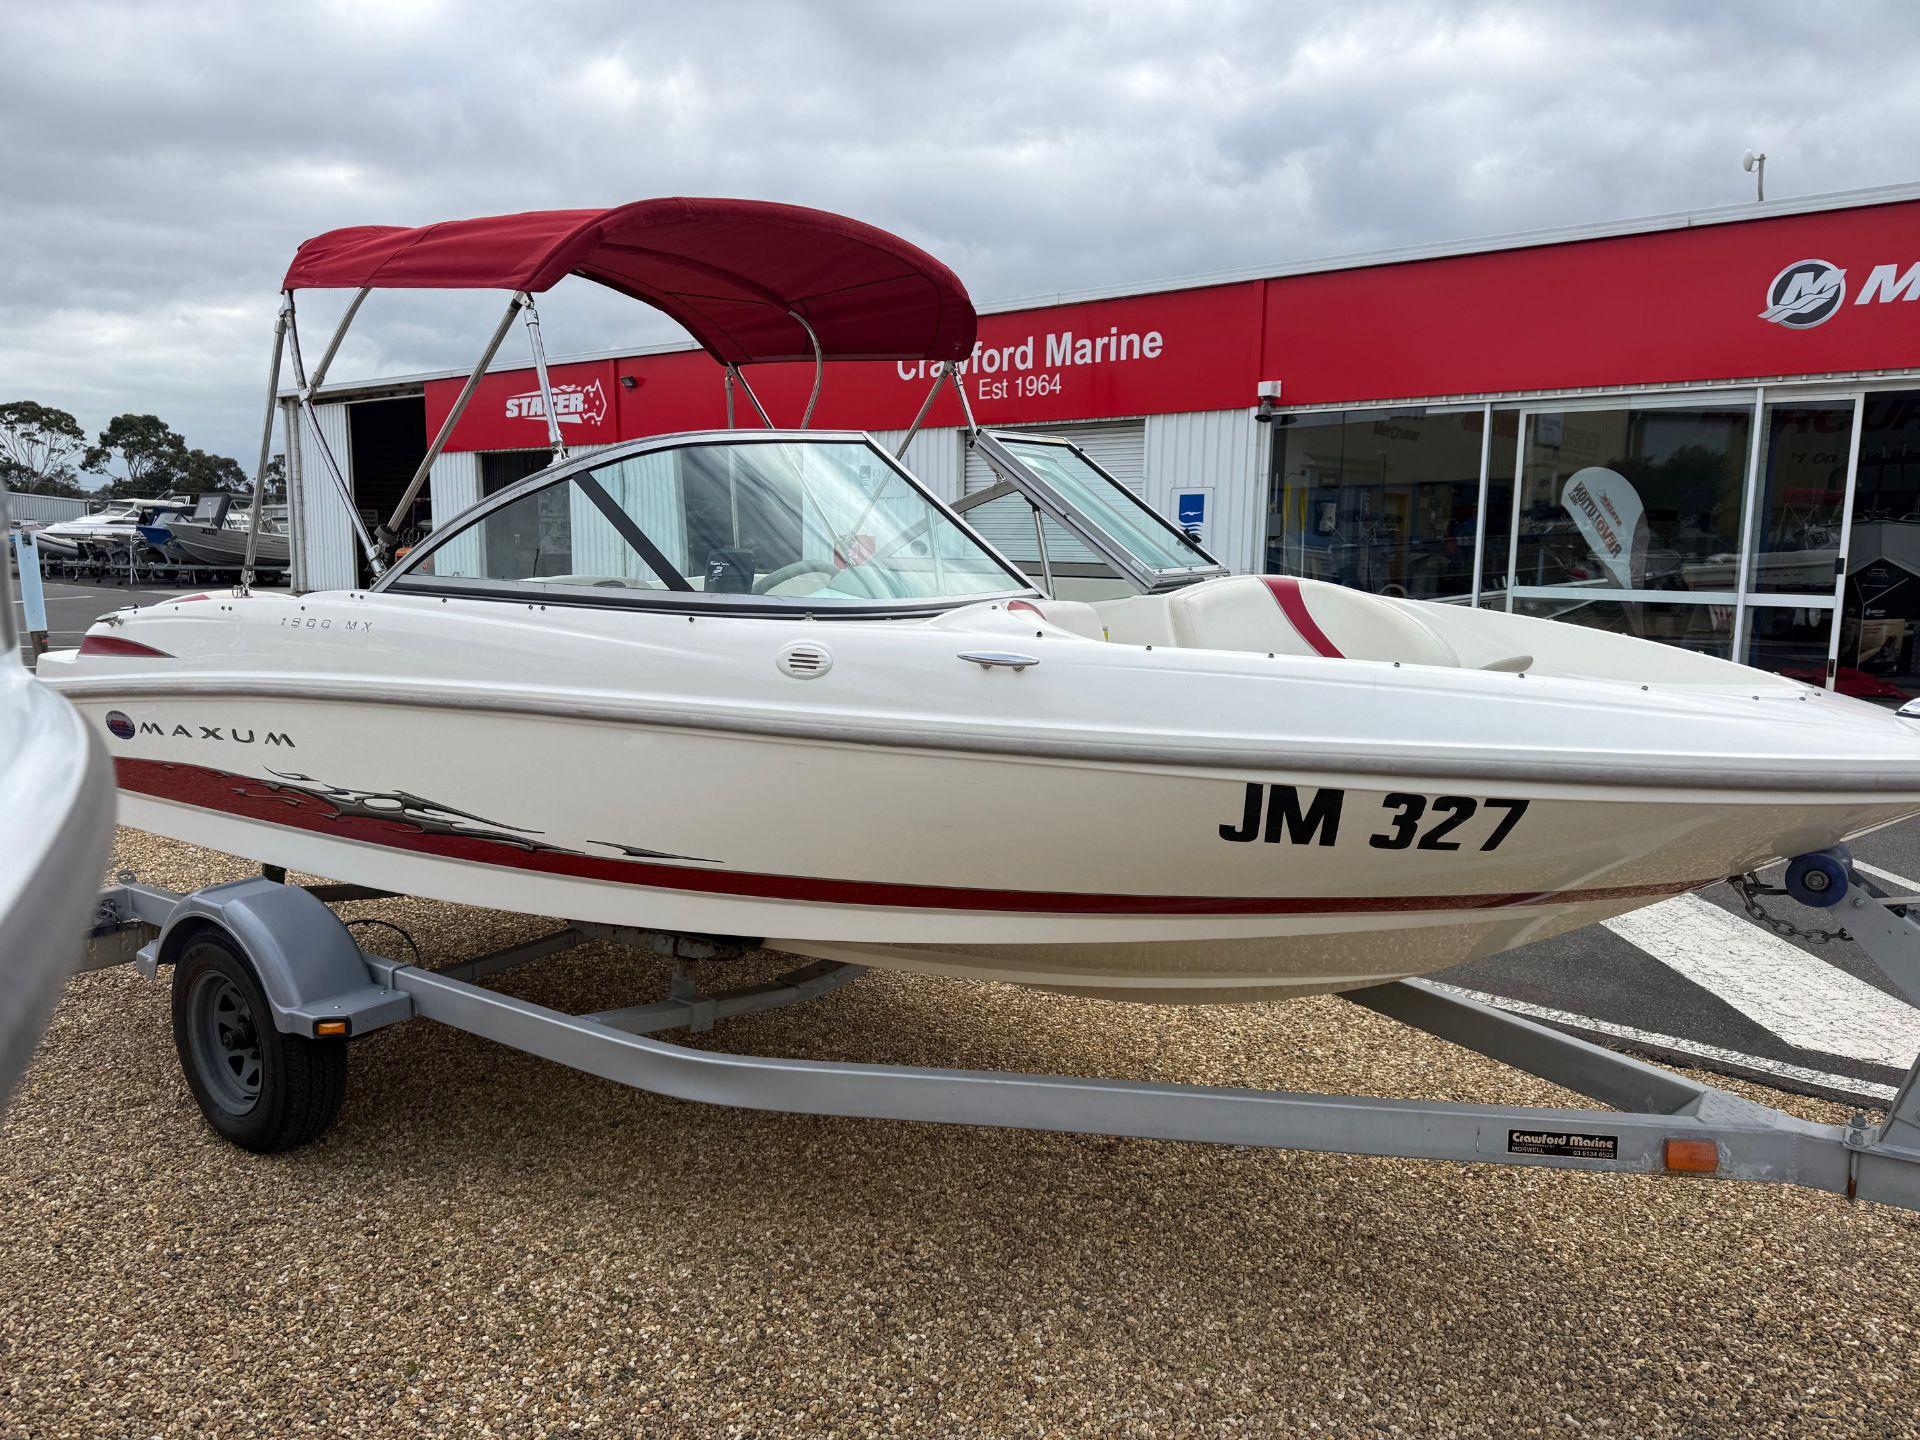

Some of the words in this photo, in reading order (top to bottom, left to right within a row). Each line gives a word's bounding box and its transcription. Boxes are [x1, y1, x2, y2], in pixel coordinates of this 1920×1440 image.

[1045, 326, 1163, 368] Marine
[978, 377, 1008, 400] Est
[1015, 372, 1062, 398] 1964
[139, 721, 296, 748] MAXUM
[1219, 782, 1345, 847] JM
[1369, 792, 1531, 852] 327
[1511, 1146, 1545, 1154] MORWELL
[1512, 1132, 1567, 1145] Crawford
[1569, 1136, 1614, 1149] Marine
